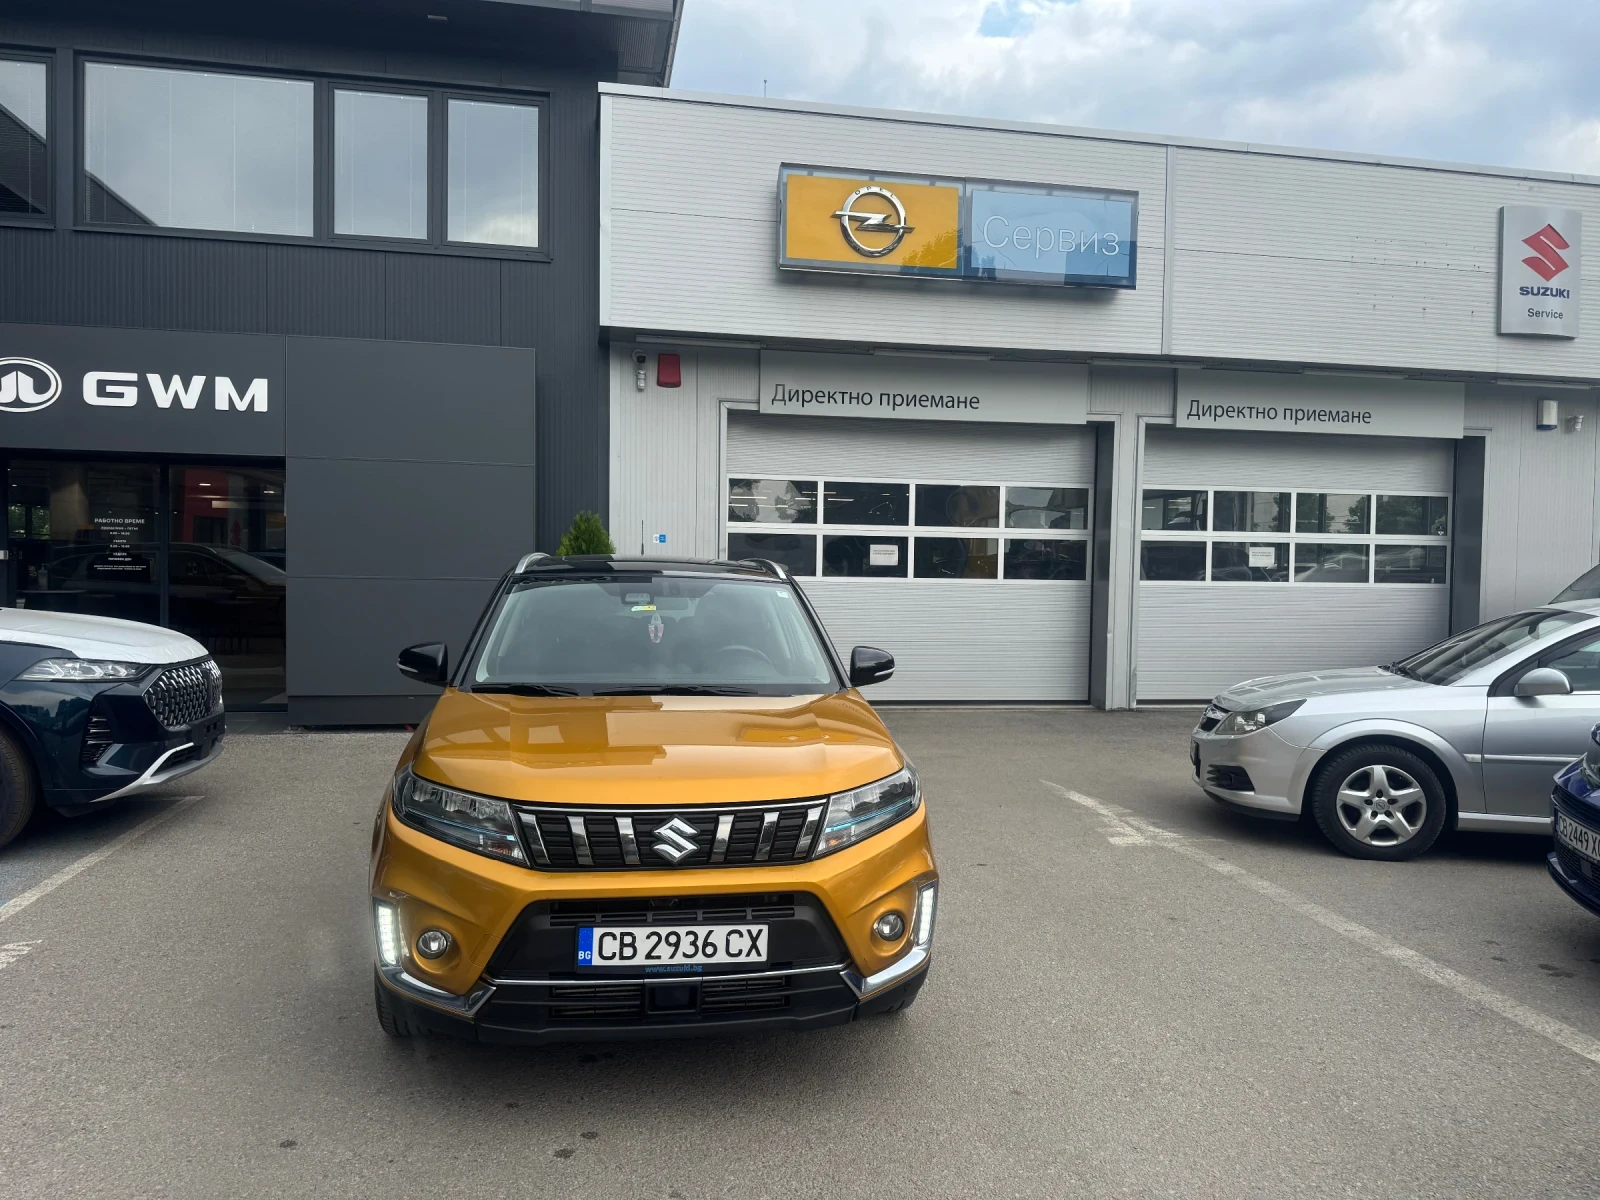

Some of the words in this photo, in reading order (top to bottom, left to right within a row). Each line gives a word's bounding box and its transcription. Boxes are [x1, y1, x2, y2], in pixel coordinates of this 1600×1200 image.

[983, 215, 1119, 259] Сервиз
[1519, 286, 1570, 299] SUZUKI
[1527, 307, 1563, 319] Service
[83, 371, 268, 412] GWM
[771, 383, 873, 407] Директно
[879, 392, 980, 411] приемане
[1187, 400, 1278, 422] Директно
[1283, 407, 1372, 425] приемане
[1568, 821, 1590, 851] 2449
[578, 951, 592, 960] BG
[598, 931, 638, 961] CB
[644, 930, 718, 960] 2936
[725, 929, 763, 958] CX
[644, 964, 703, 973] www.suzuki.bg
